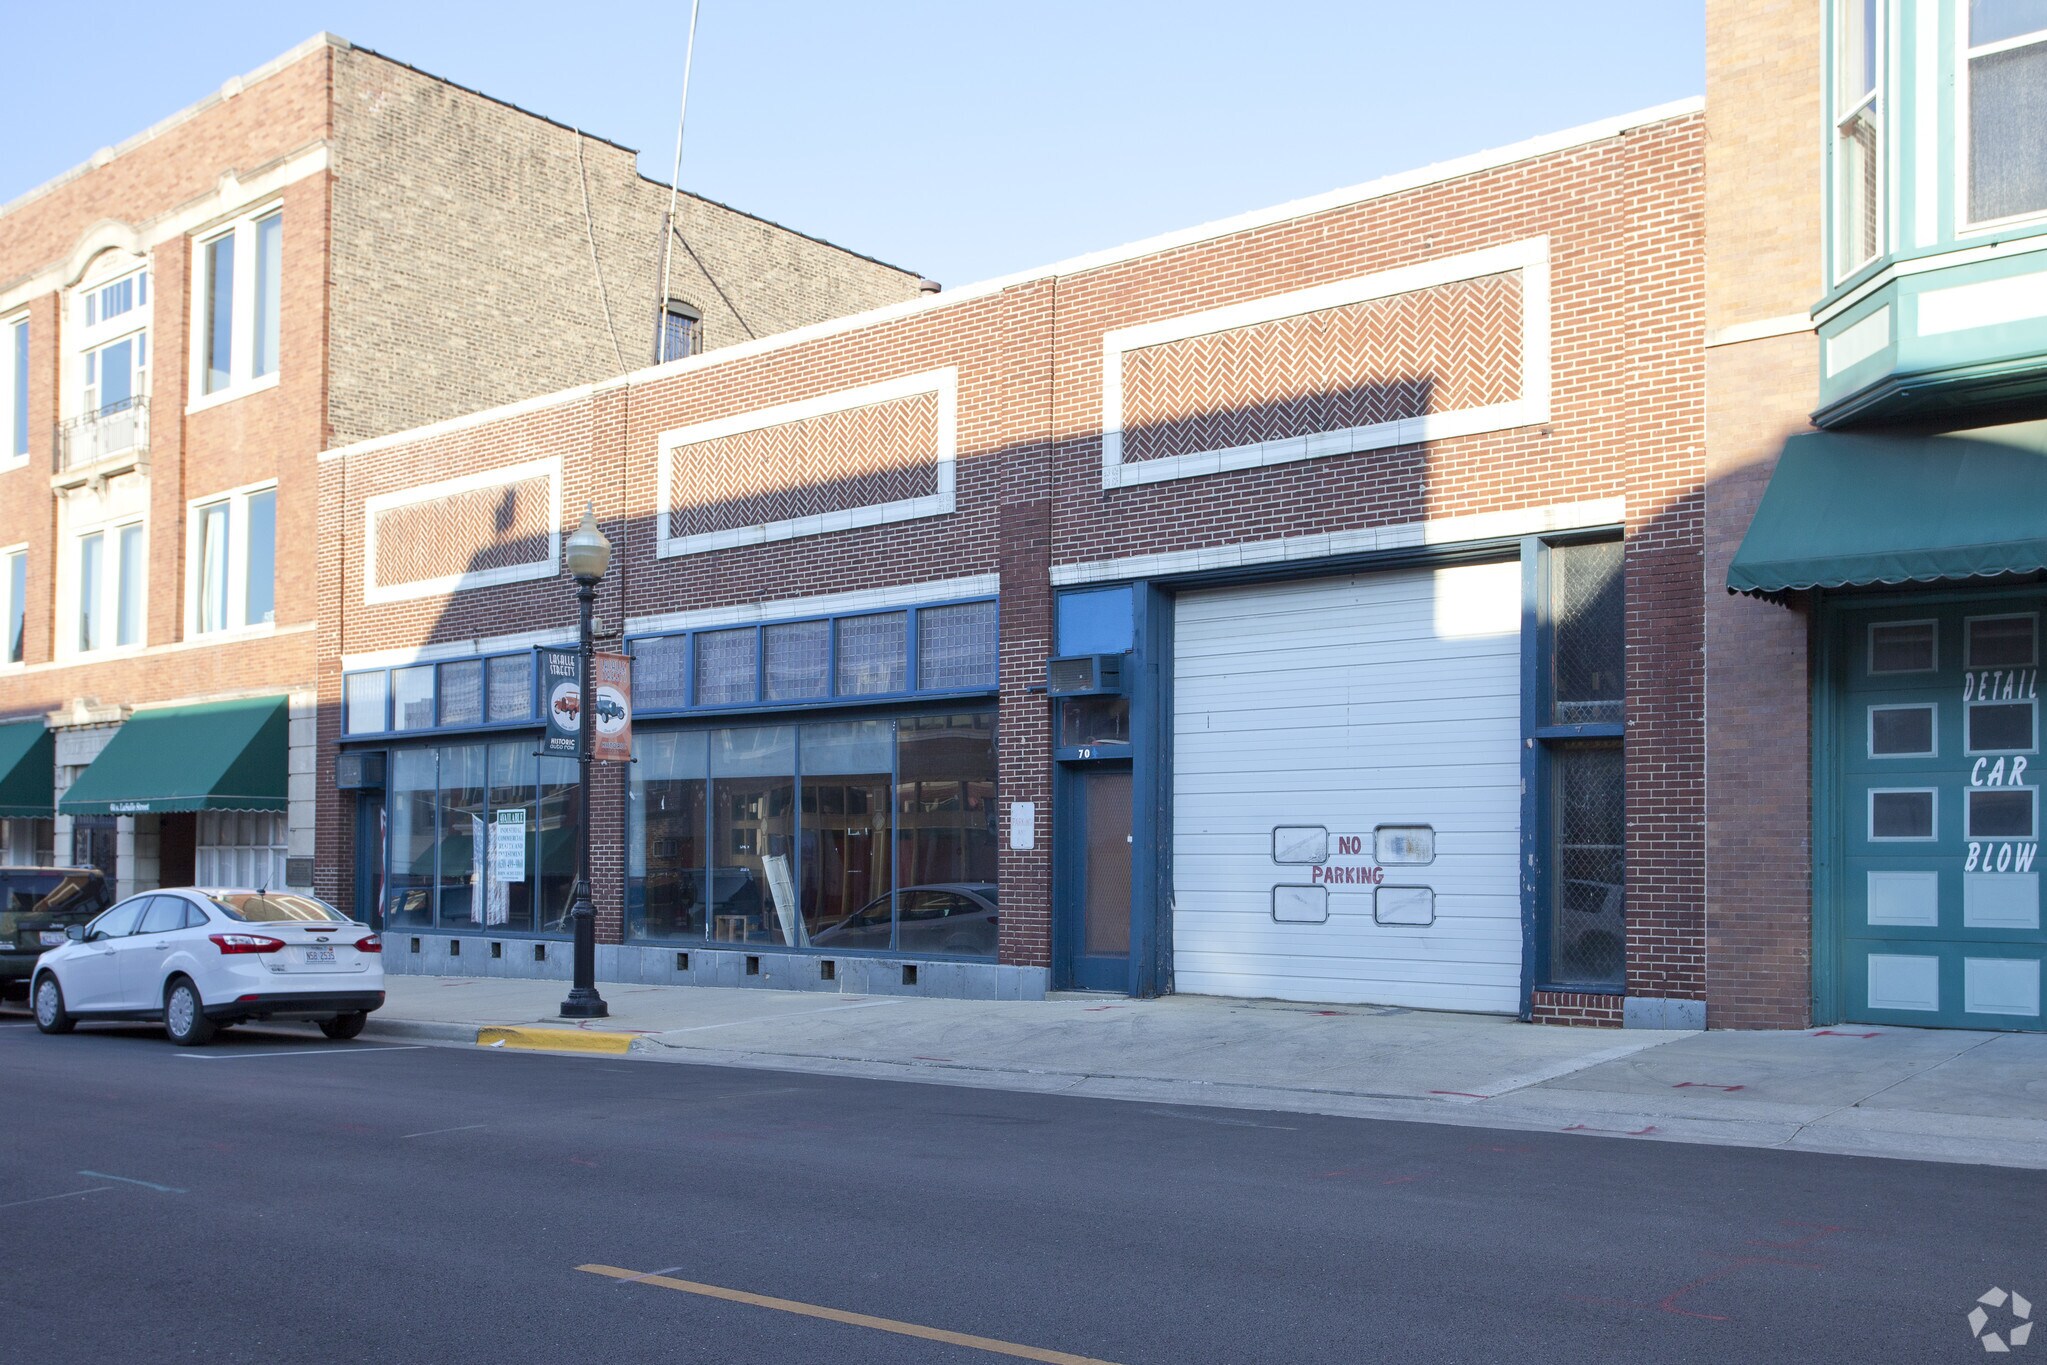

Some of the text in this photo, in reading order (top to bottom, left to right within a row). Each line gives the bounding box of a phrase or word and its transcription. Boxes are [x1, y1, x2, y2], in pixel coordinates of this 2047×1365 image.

[548, 653, 575, 667] LASALLE
[1963, 669, 2037, 701] DETAIL
[550, 738, 575, 746] HISTORIC
[1078, 749, 1090, 759] 70
[1971, 755, 2027, 787] CAR
[500, 812, 524, 823] AVAILABLE
[1338, 836, 1361, 855] NO
[1964, 842, 2038, 873] BLOW
[1312, 865, 1384, 885] PARKING
